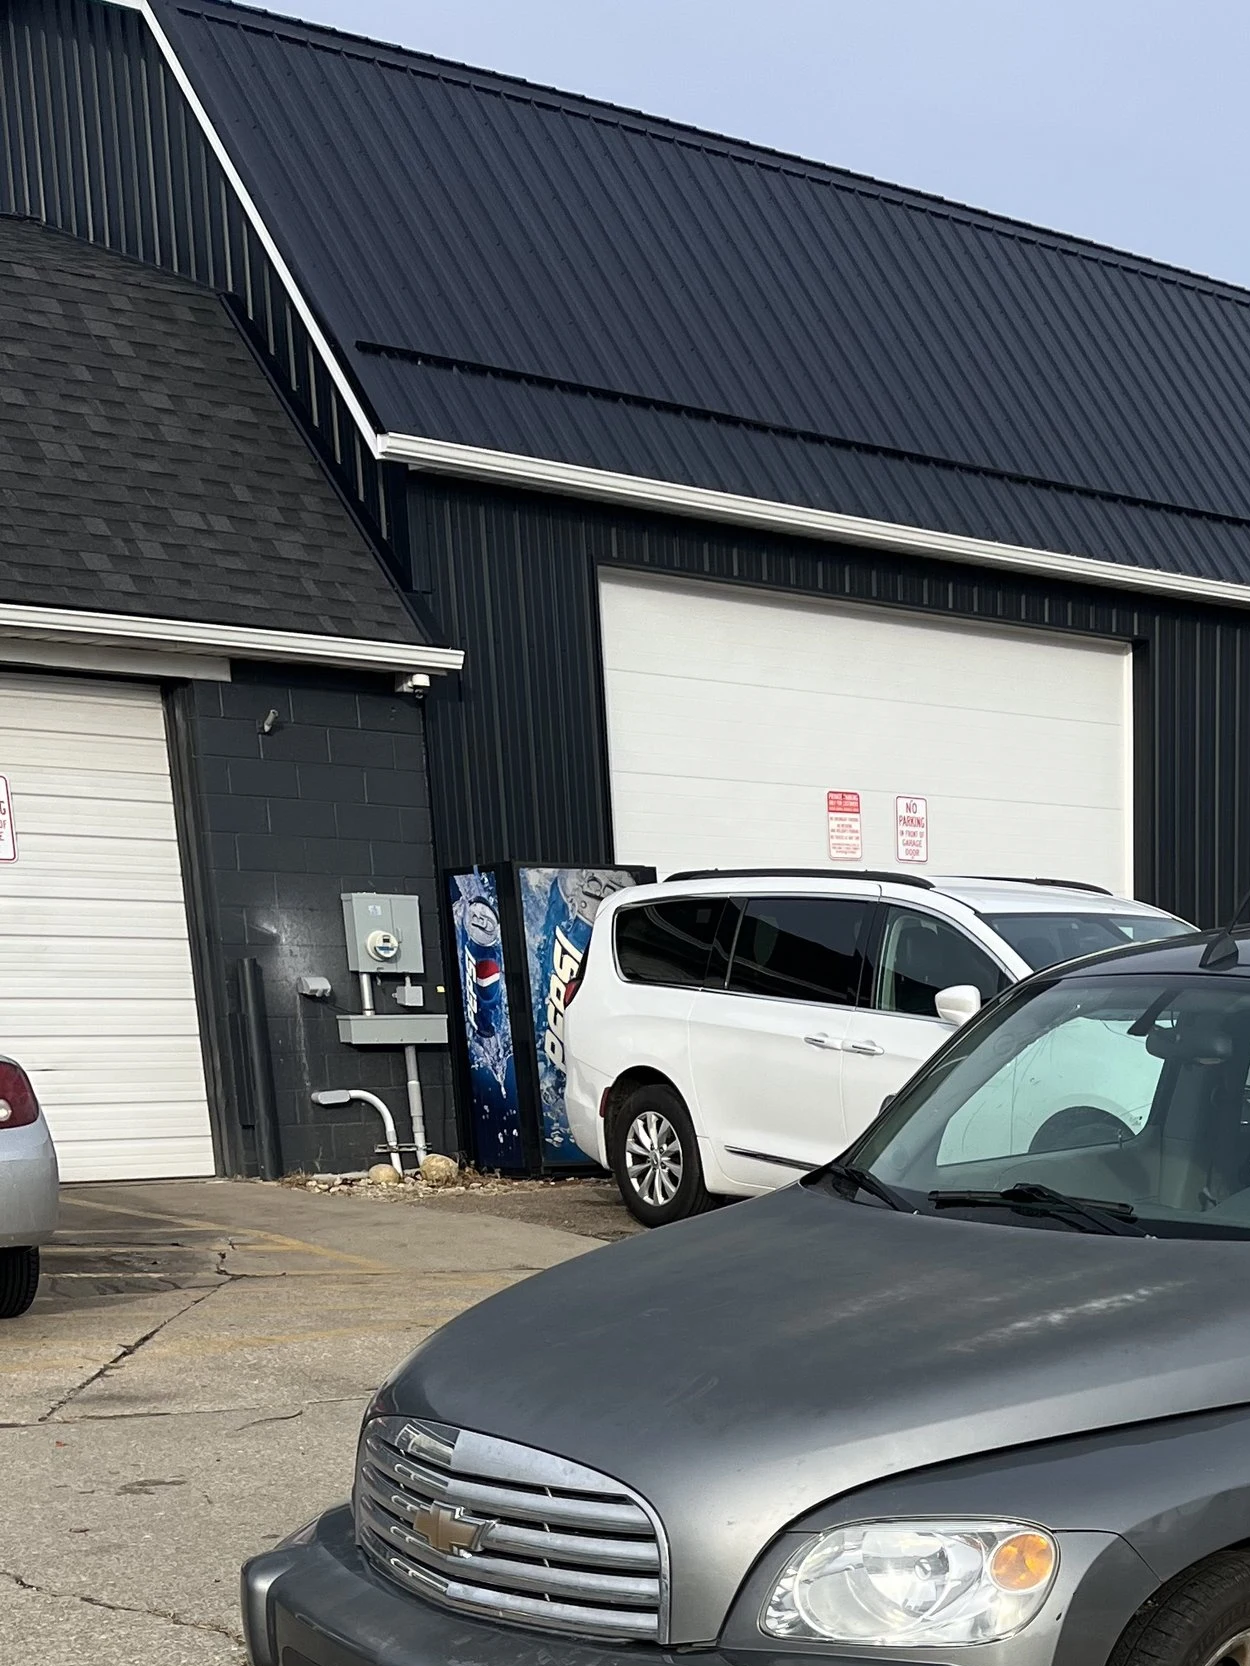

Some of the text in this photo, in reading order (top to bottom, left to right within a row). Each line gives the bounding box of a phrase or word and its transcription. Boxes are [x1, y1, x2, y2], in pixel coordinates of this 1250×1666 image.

[906, 802, 917, 814] NO
[899, 815, 925, 828] PARKING
[902, 839, 922, 847] GARAGE
[464, 944, 478, 1031] PEPSI
[544, 925, 584, 1076] PEPSI
